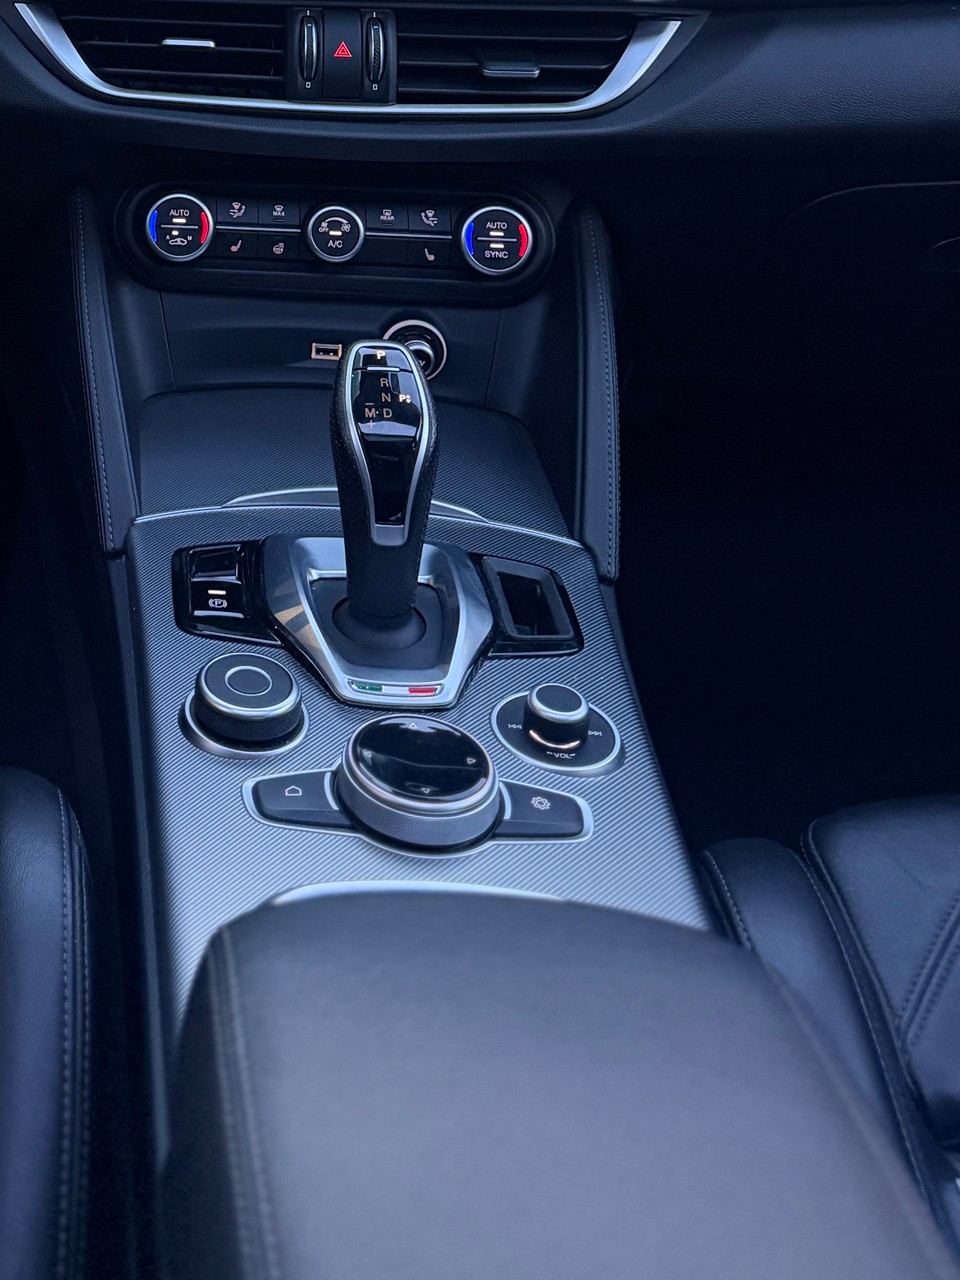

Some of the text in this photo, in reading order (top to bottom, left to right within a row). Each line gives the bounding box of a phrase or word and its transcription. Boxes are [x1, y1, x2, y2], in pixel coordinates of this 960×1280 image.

[169, 209, 190, 217] AUTO
[485, 221, 507, 229] AUTO
[327, 240, 343, 248] A/C
[484, 250, 509, 259] SYNC
[376, 350, 386, 360] P
[380, 377, 389, 388] R
[381, 392, 391, 402] N
[364, 407, 392, 418] M D
